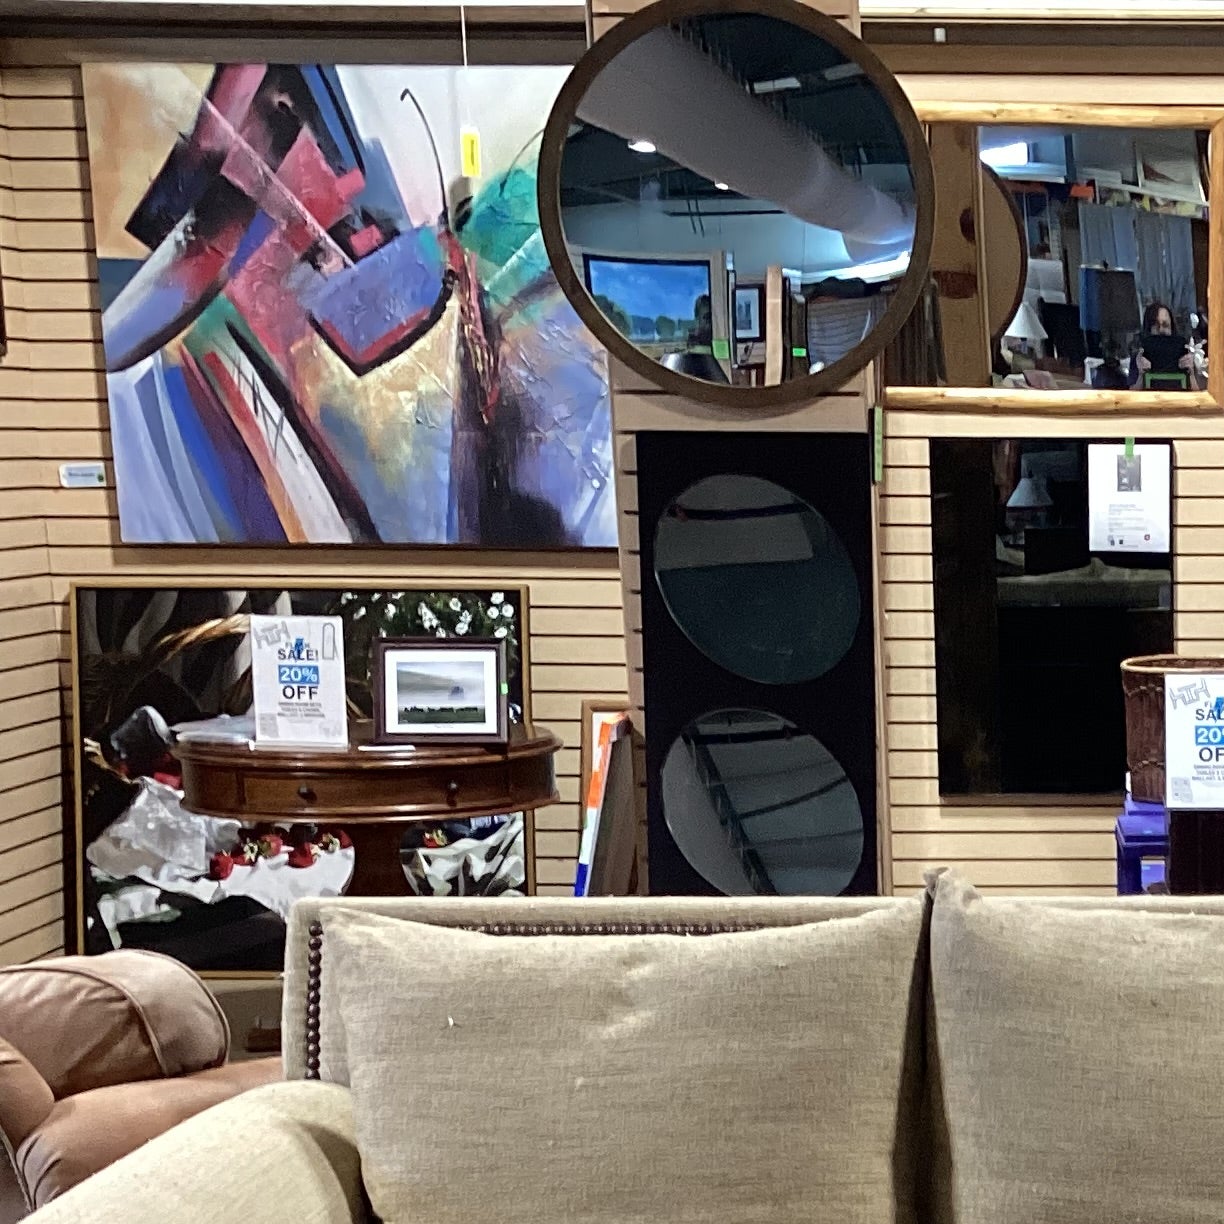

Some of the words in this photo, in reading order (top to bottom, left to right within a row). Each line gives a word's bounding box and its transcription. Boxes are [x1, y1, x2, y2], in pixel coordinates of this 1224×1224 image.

[278, 649, 319, 661] SALE!
[280, 667, 317, 682] 20%
[283, 685, 318, 700] OFF
